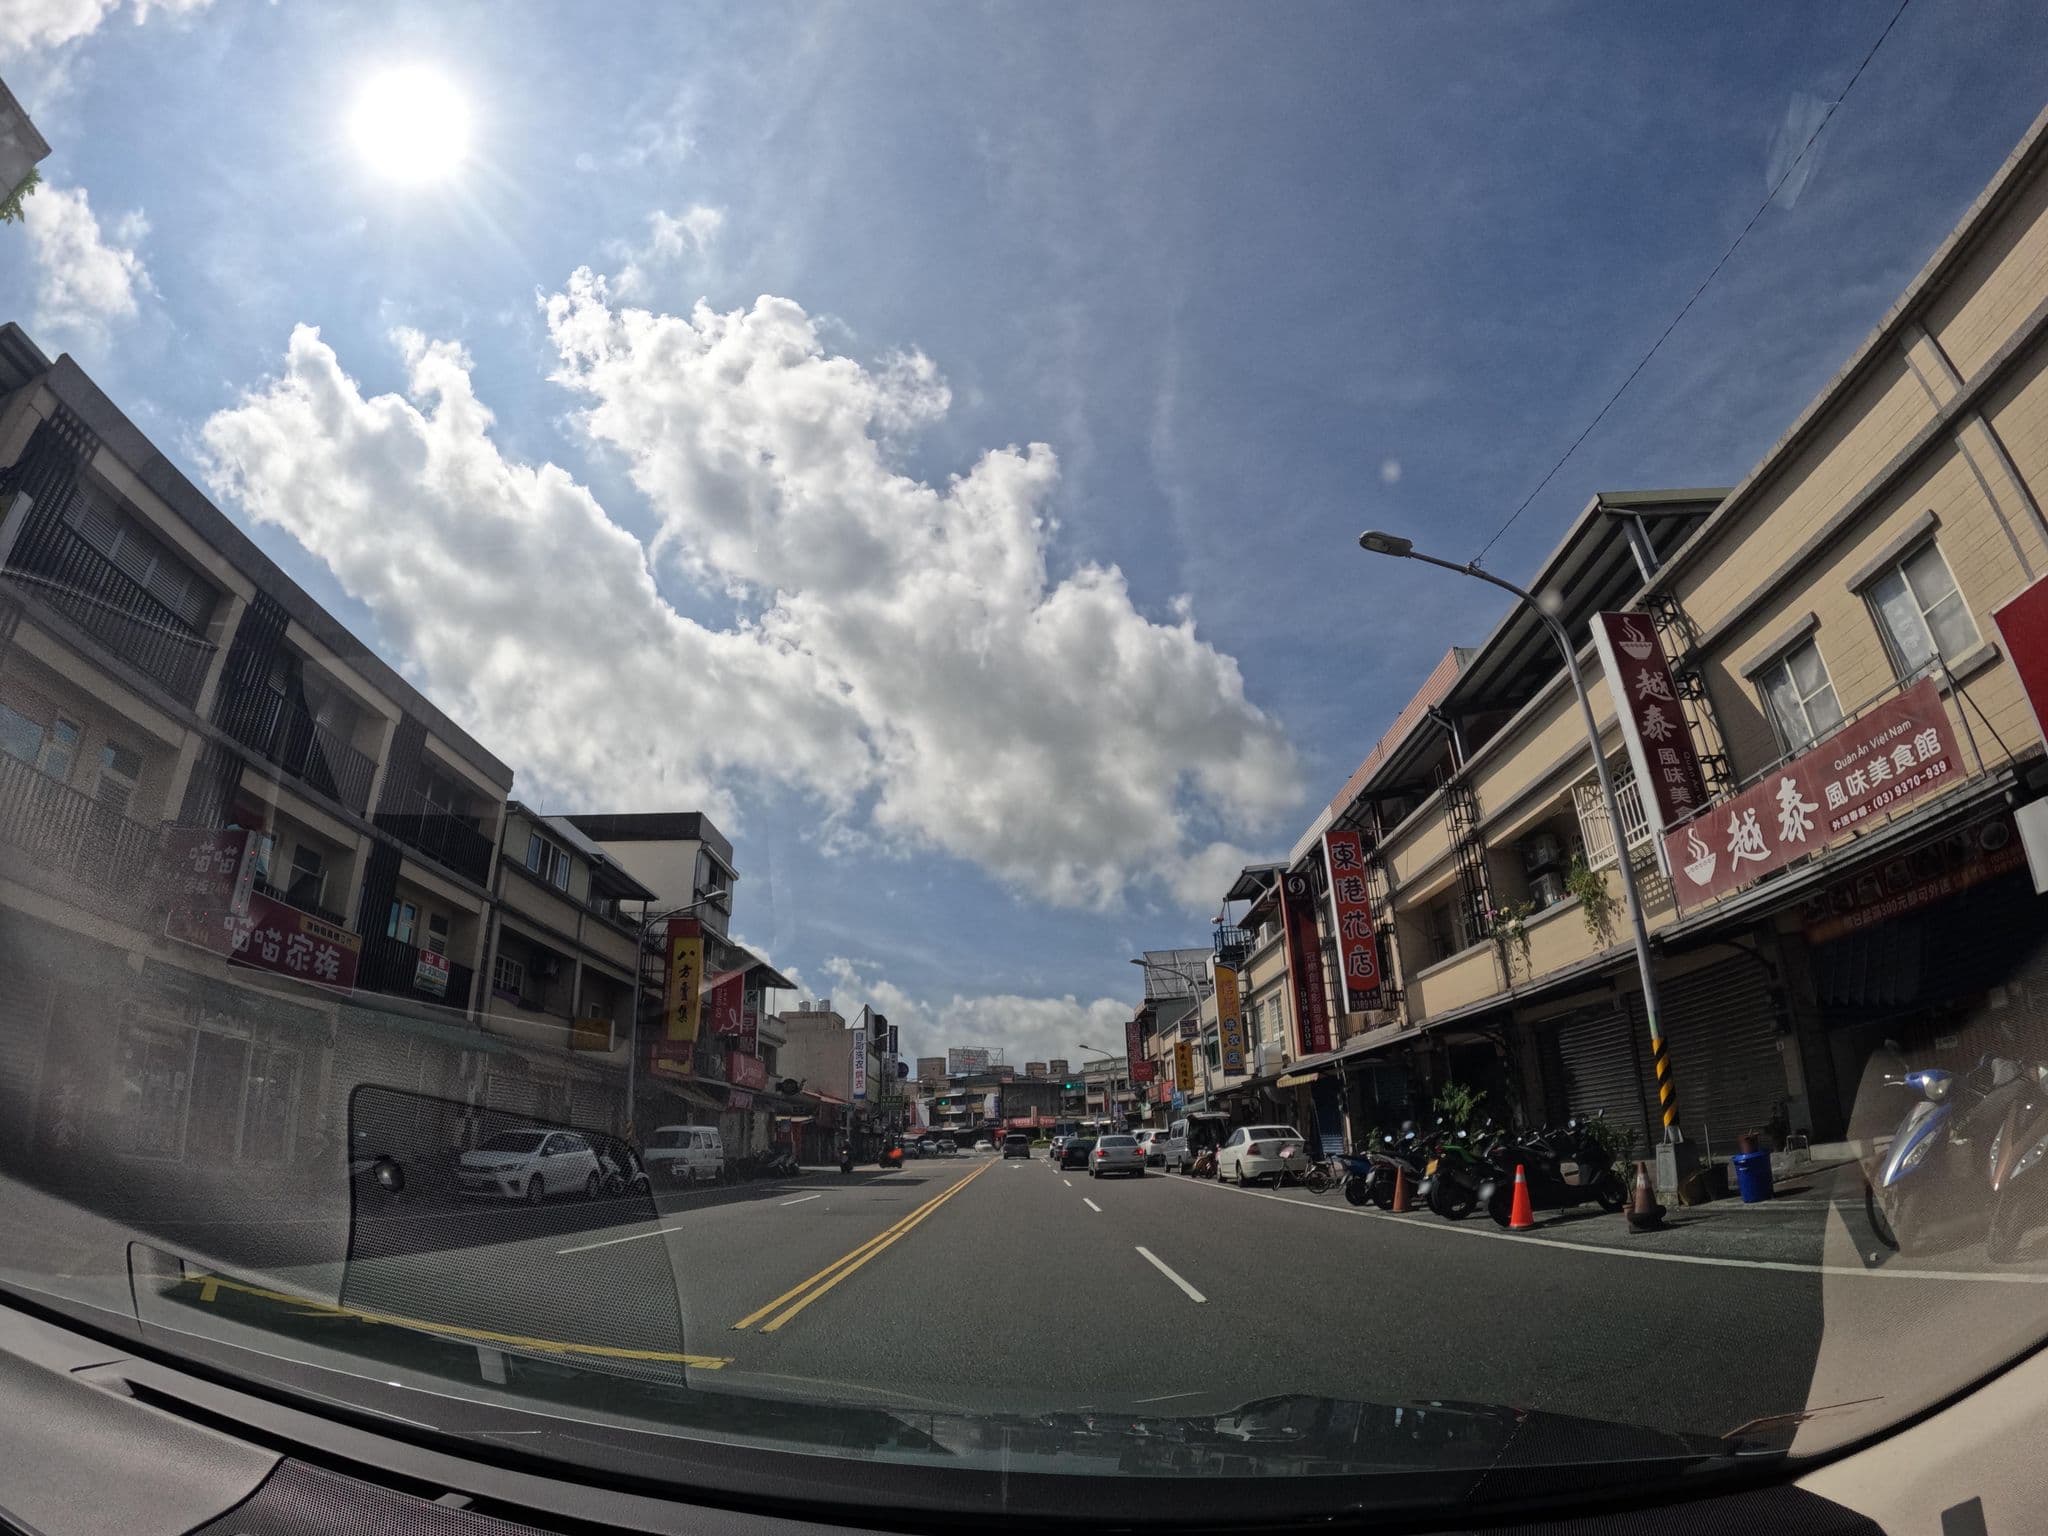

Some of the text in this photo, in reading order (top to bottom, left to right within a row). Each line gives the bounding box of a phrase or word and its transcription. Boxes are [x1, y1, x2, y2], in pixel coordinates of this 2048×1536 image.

[1635, 667, 1678, 742] 越泰
[1889, 719, 1912, 739] Nam
[1824, 727, 1942, 812] 風味美食館
[1895, 760, 1948, 797] 9370-939
[1726, 777, 1819, 872] 越泰
[1331, 842, 1375, 978] 東港花店
[224, 916, 340, 980] 喵喵家族
[677, 949, 695, 1023] 八方雲集
